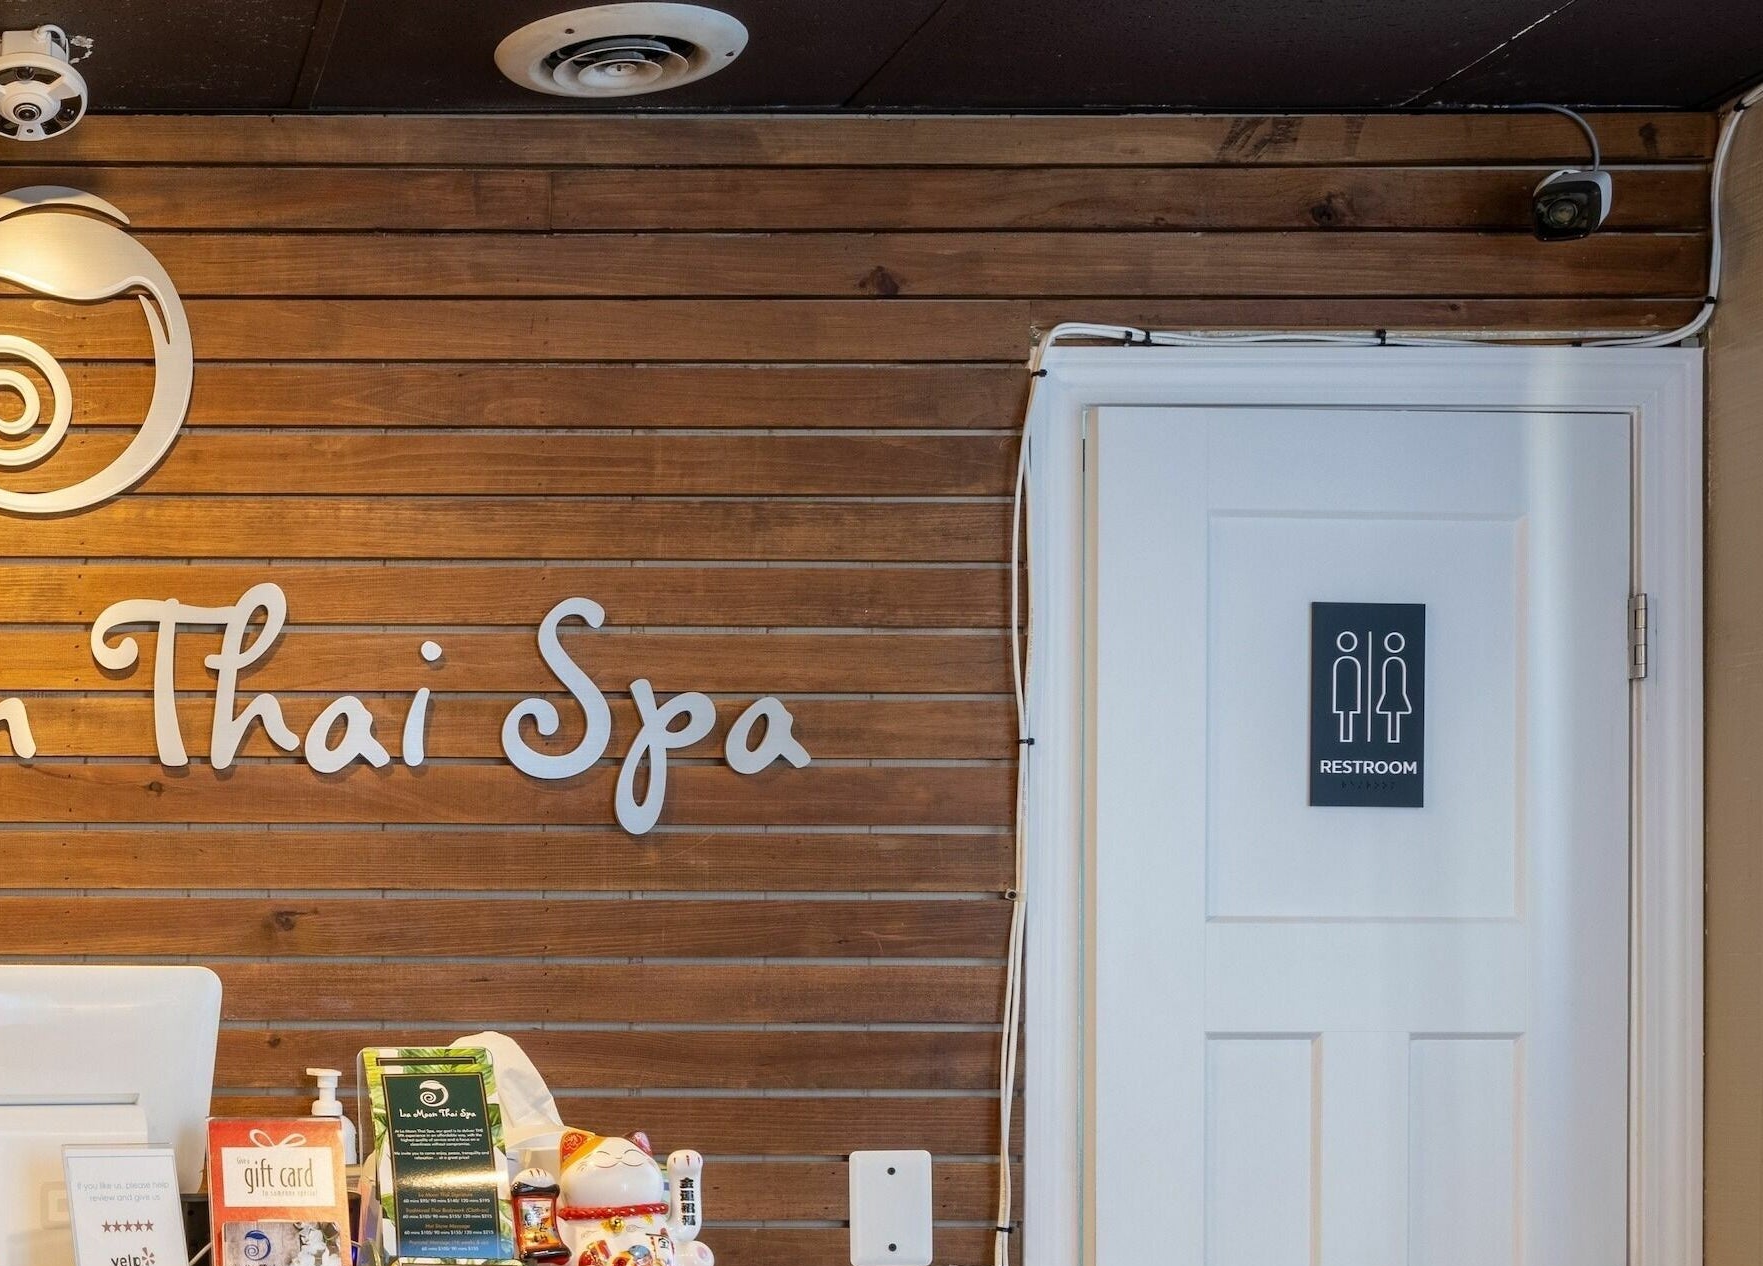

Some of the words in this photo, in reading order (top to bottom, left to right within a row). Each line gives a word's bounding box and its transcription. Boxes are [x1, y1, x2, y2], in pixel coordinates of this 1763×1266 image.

[90, 582, 446, 775] Thai
[501, 597, 813, 836] Spa
[1320, 760, 1417, 774] RESTROOM
[399, 1108, 411, 1118] La
[413, 1109, 438, 1118] Moon
[438, 1108, 457, 1117] Thai
[460, 1108, 476, 1119] Spa
[244, 1158, 274, 1194] gift
[280, 1158, 313, 1187] card
